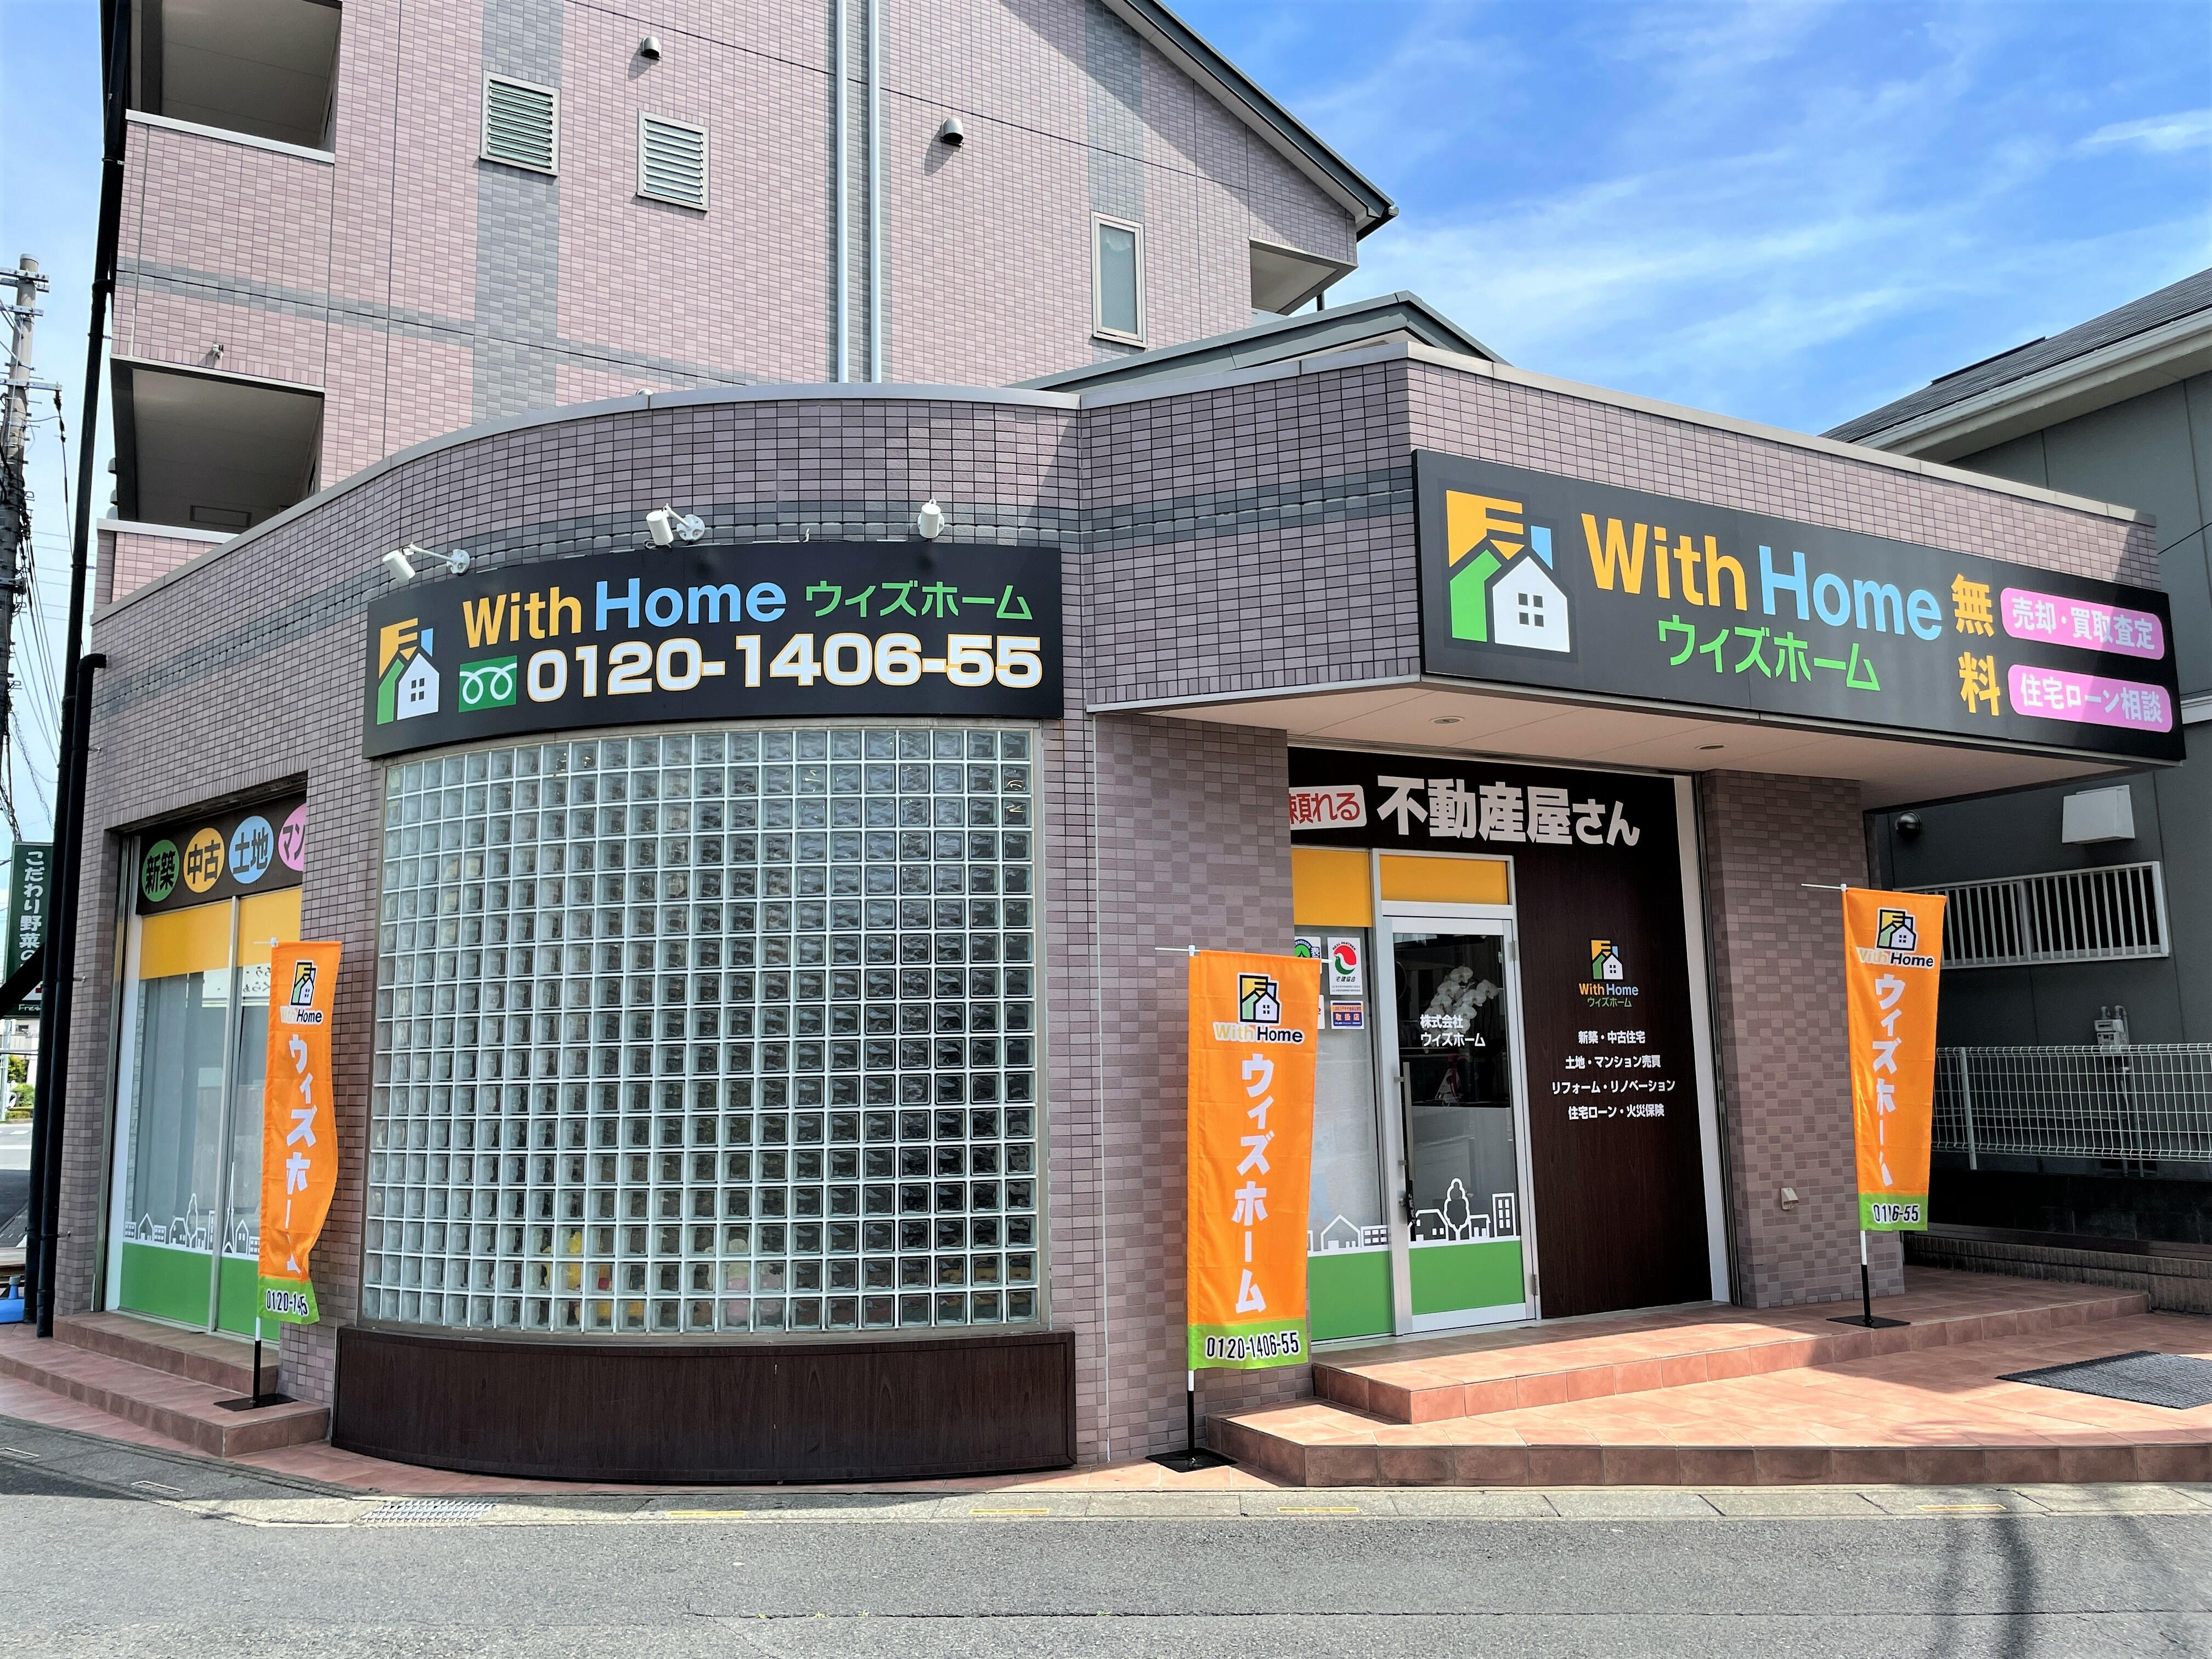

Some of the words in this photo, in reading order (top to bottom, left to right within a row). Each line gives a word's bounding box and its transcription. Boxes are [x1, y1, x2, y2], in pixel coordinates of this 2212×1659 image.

[1581, 514, 1747, 611] With
[1759, 545, 1942, 640] Home
[463, 586, 581, 648] With
[595, 578, 786, 631] Home
[805, 581, 1032, 620] ウィズホーム
[2012, 596, 2155, 650] 売却・買取査定
[1658, 614, 1880, 691] ウィズホーム
[527, 633, 1041, 702] 0120-1406-55
[2021, 673, 2163, 724] 住宅ローン相談
[1376, 775, 1640, 847] 不動産屋さん
[145, 850, 175, 894] 新築
[187, 839, 221, 884] 中古
[233, 827, 268, 874] 土地
[1891, 952, 1933, 967] Home
[1579, 983, 1605, 995] With
[1606, 983, 1639, 996] Home
[1587, 997, 1632, 1008] ウィズホーム
[297, 1009, 321, 1022] Home
[1420, 1014, 1463, 1029] 株式会社
[1216, 1024, 1254, 1041] With
[1257, 1026, 1302, 1042] Home
[1421, 1032, 1486, 1047] ウィズホーム
[1578, 1030, 1645, 1044] 新築・中古住宅
[1565, 1055, 1661, 1069] 土地・マンション売買
[1551, 1080, 1675, 1094] リフォーム・リノベーション
[1568, 1104, 1664, 1120] 住宅ローン・火災保険
[1231, 1053, 1275, 1313] ウィズホーム
[1207, 1332, 1299, 1359] 0120-1406-55
